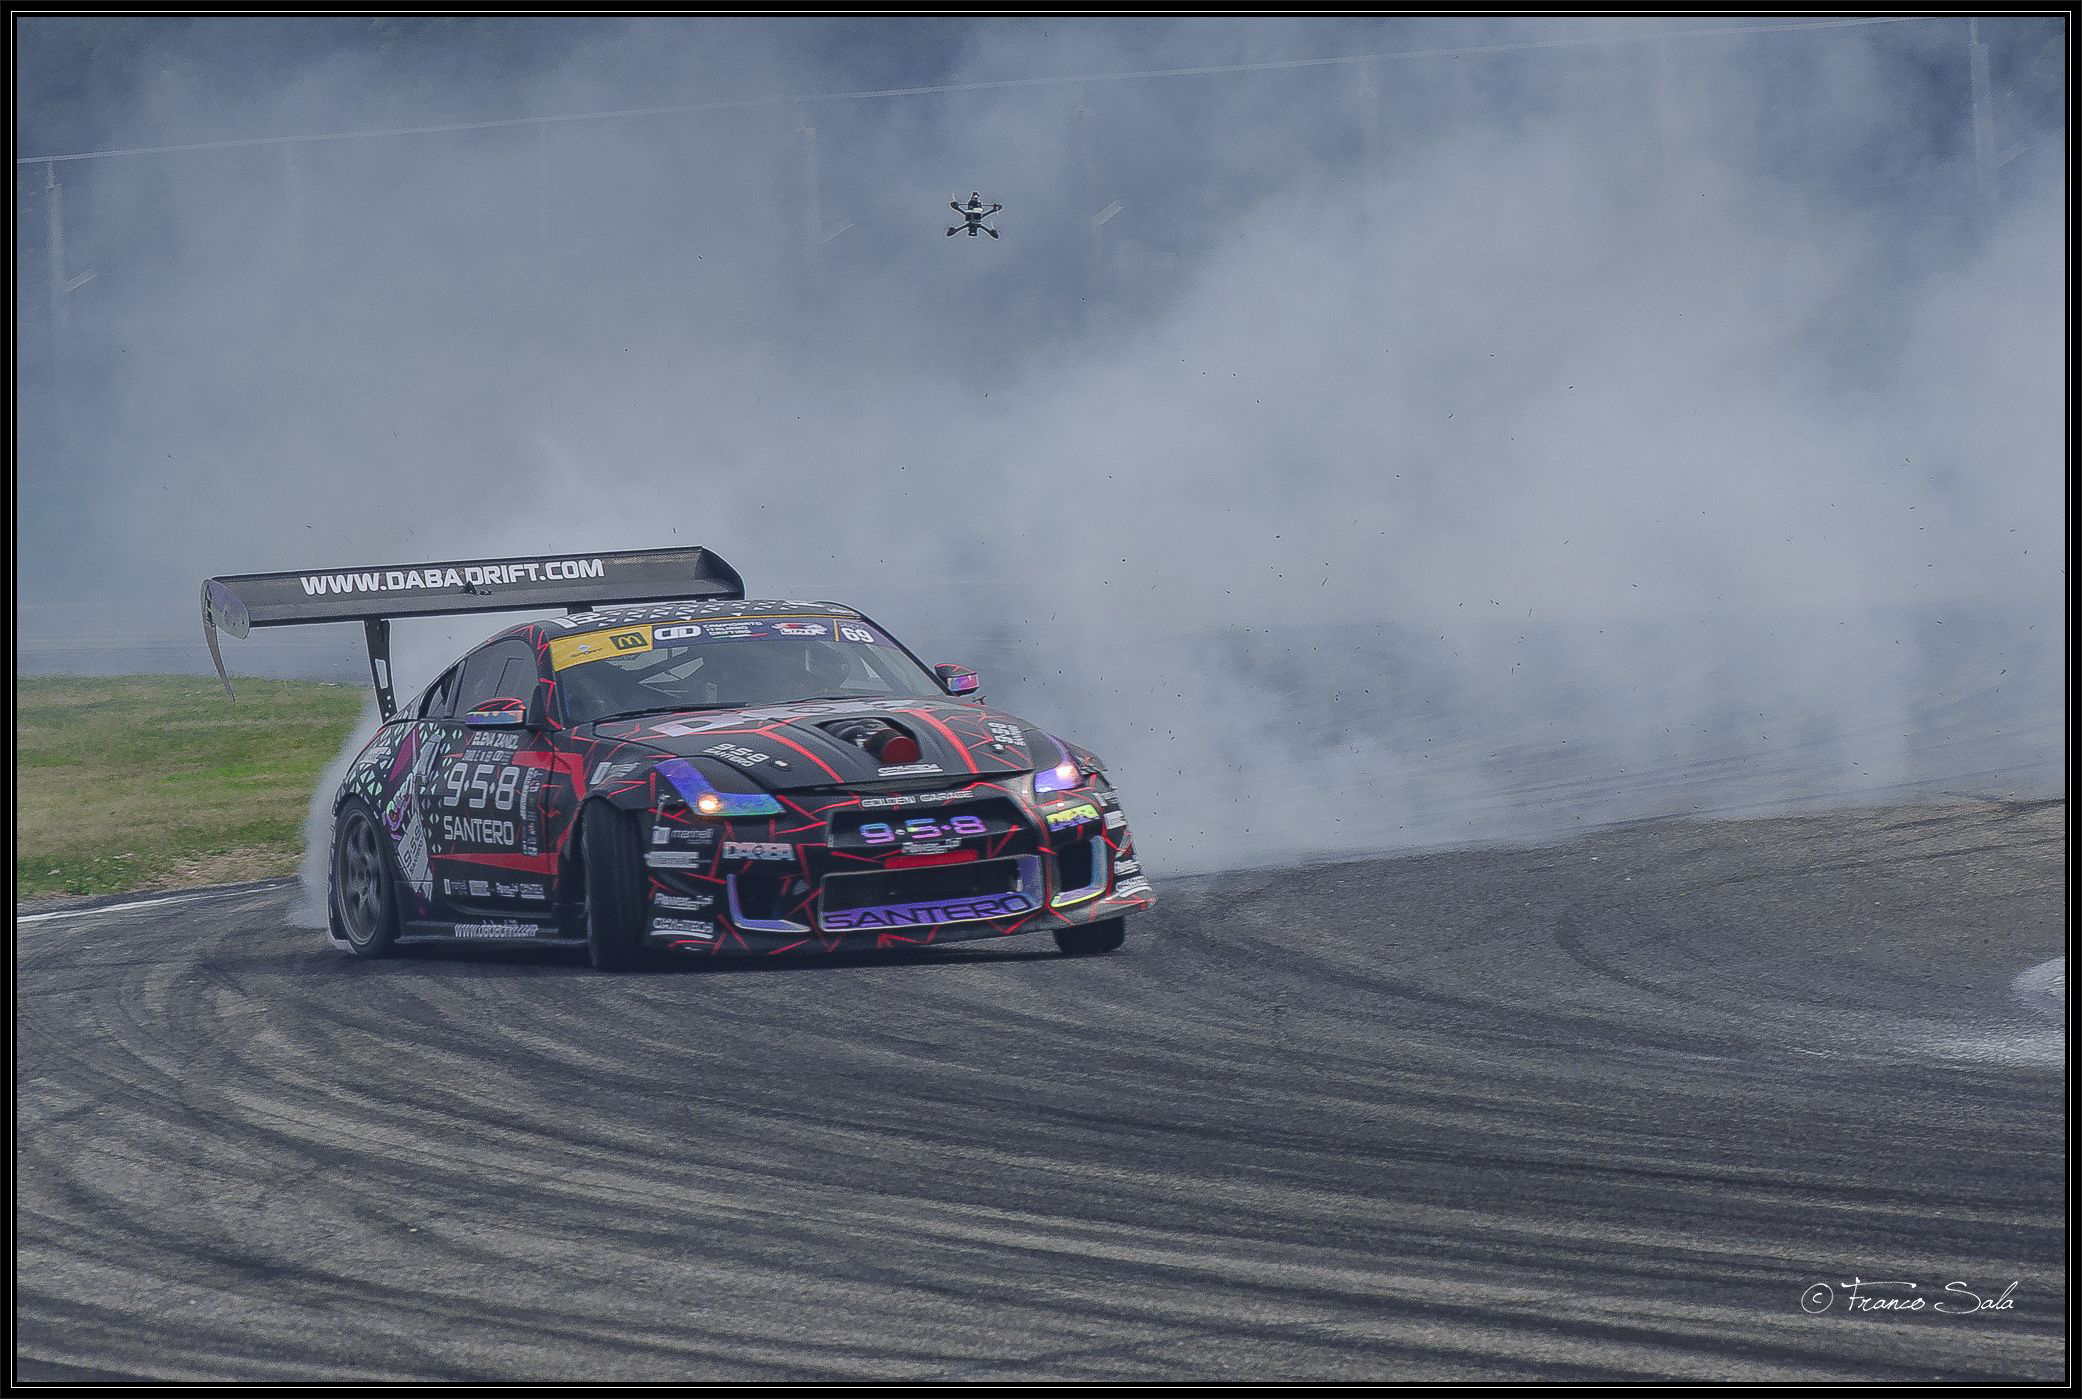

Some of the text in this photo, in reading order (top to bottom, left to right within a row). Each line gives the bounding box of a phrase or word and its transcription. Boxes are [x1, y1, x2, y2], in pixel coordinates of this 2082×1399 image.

[300, 559, 605, 596] WWW.DABADRIFT.COM
[840, 627, 876, 643] 69
[443, 815, 515, 846] SANTERO
[823, 895, 1031, 930] SANTERO
